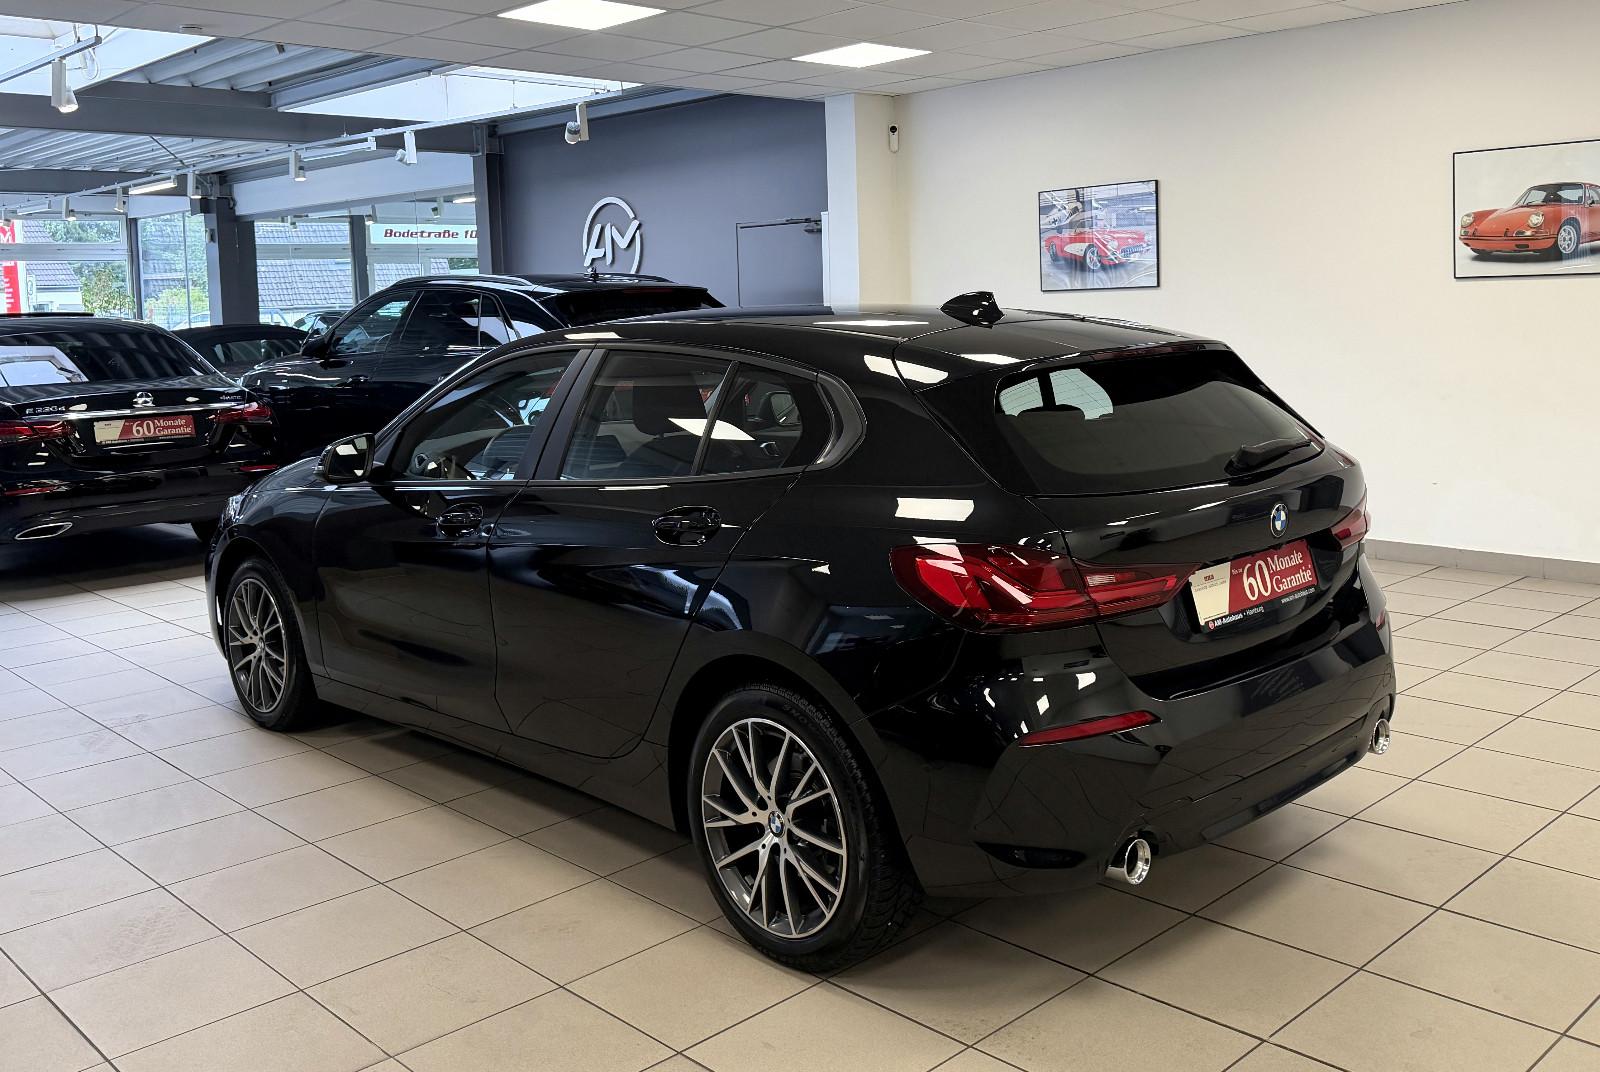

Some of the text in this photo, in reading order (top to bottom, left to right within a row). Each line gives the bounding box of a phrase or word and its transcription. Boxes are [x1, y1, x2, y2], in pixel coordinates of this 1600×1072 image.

[132, 420, 155, 437] 60
[154, 418, 186, 427] Monate
[1266, 549, 1304, 574] Monate
[1242, 559, 1272, 601] 60
